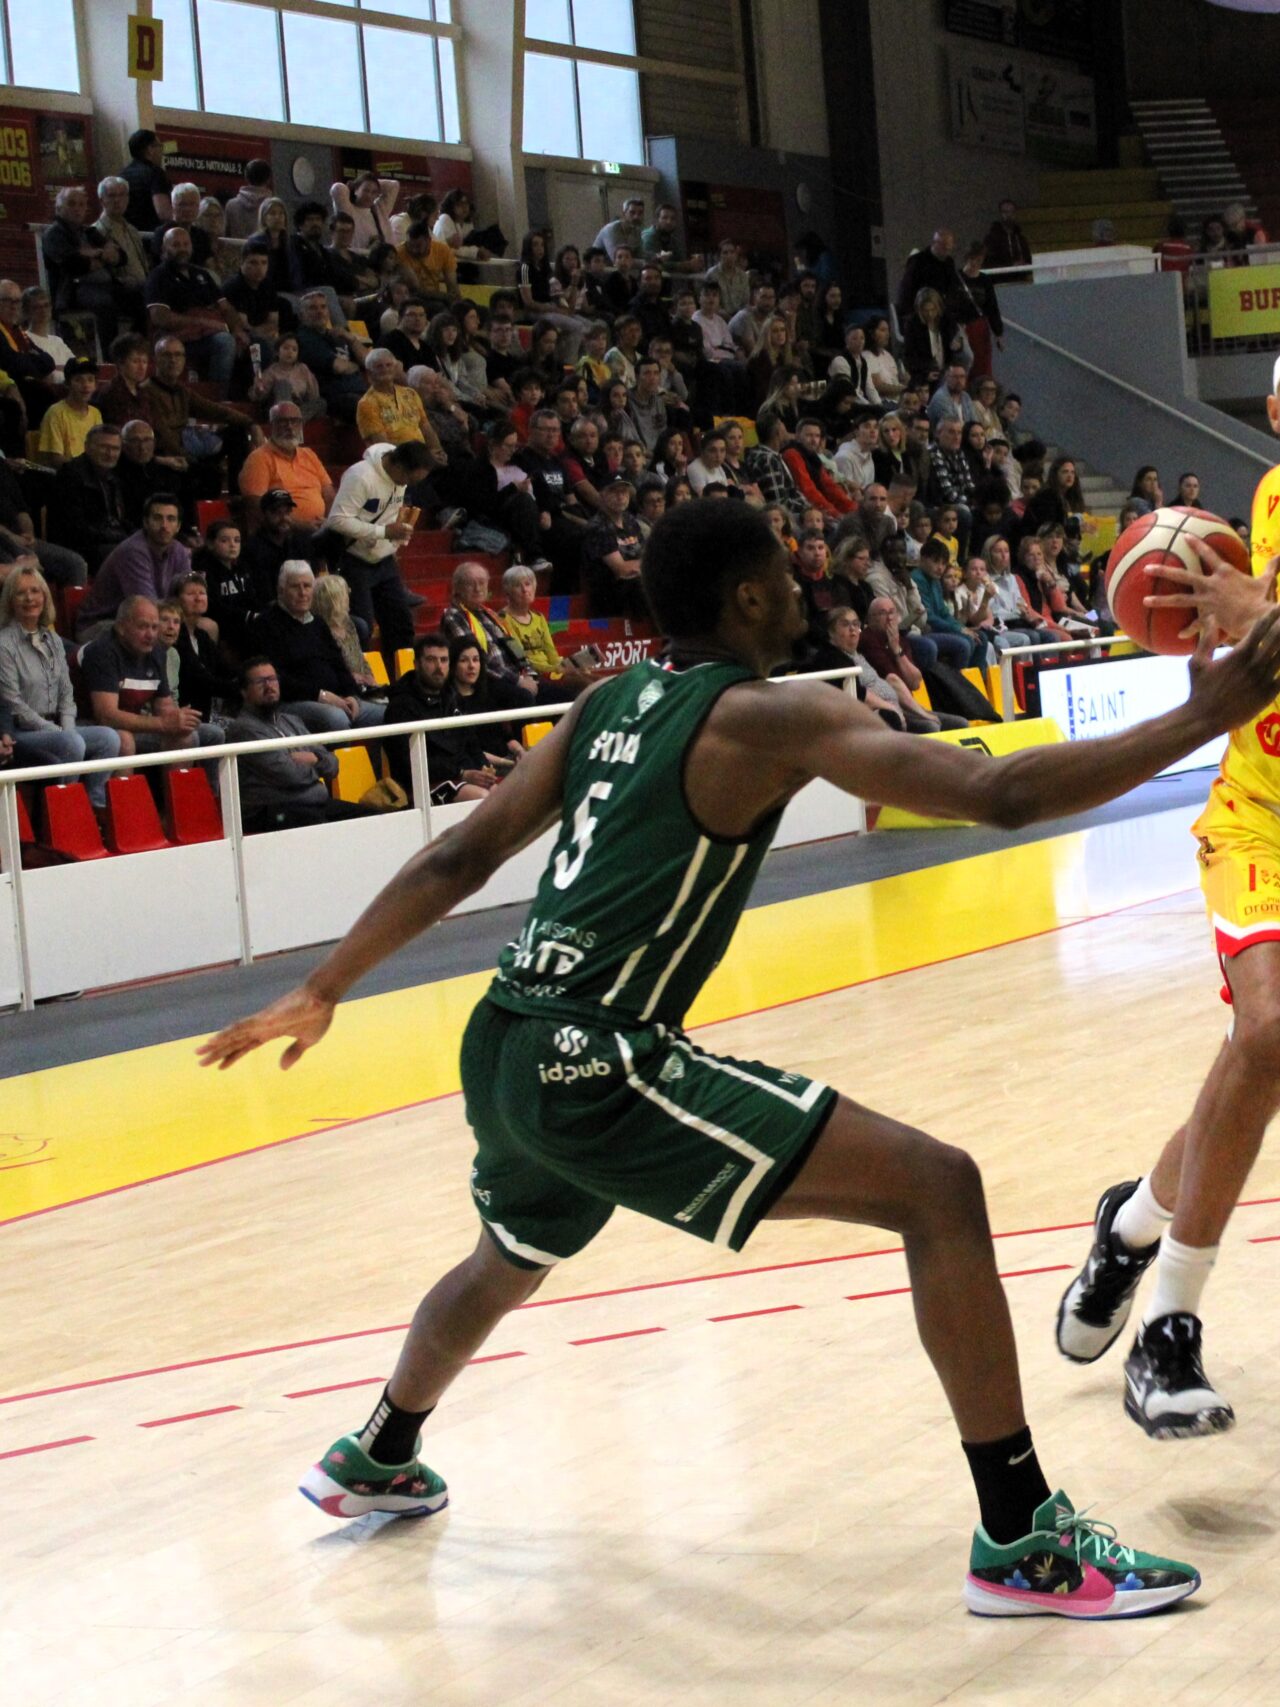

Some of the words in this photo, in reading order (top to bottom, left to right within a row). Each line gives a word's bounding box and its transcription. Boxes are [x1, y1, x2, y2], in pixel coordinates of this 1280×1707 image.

[136, 25, 155, 71] D
[1078, 690, 1125, 725] SAINT
[553, 782, 613, 891] 5
